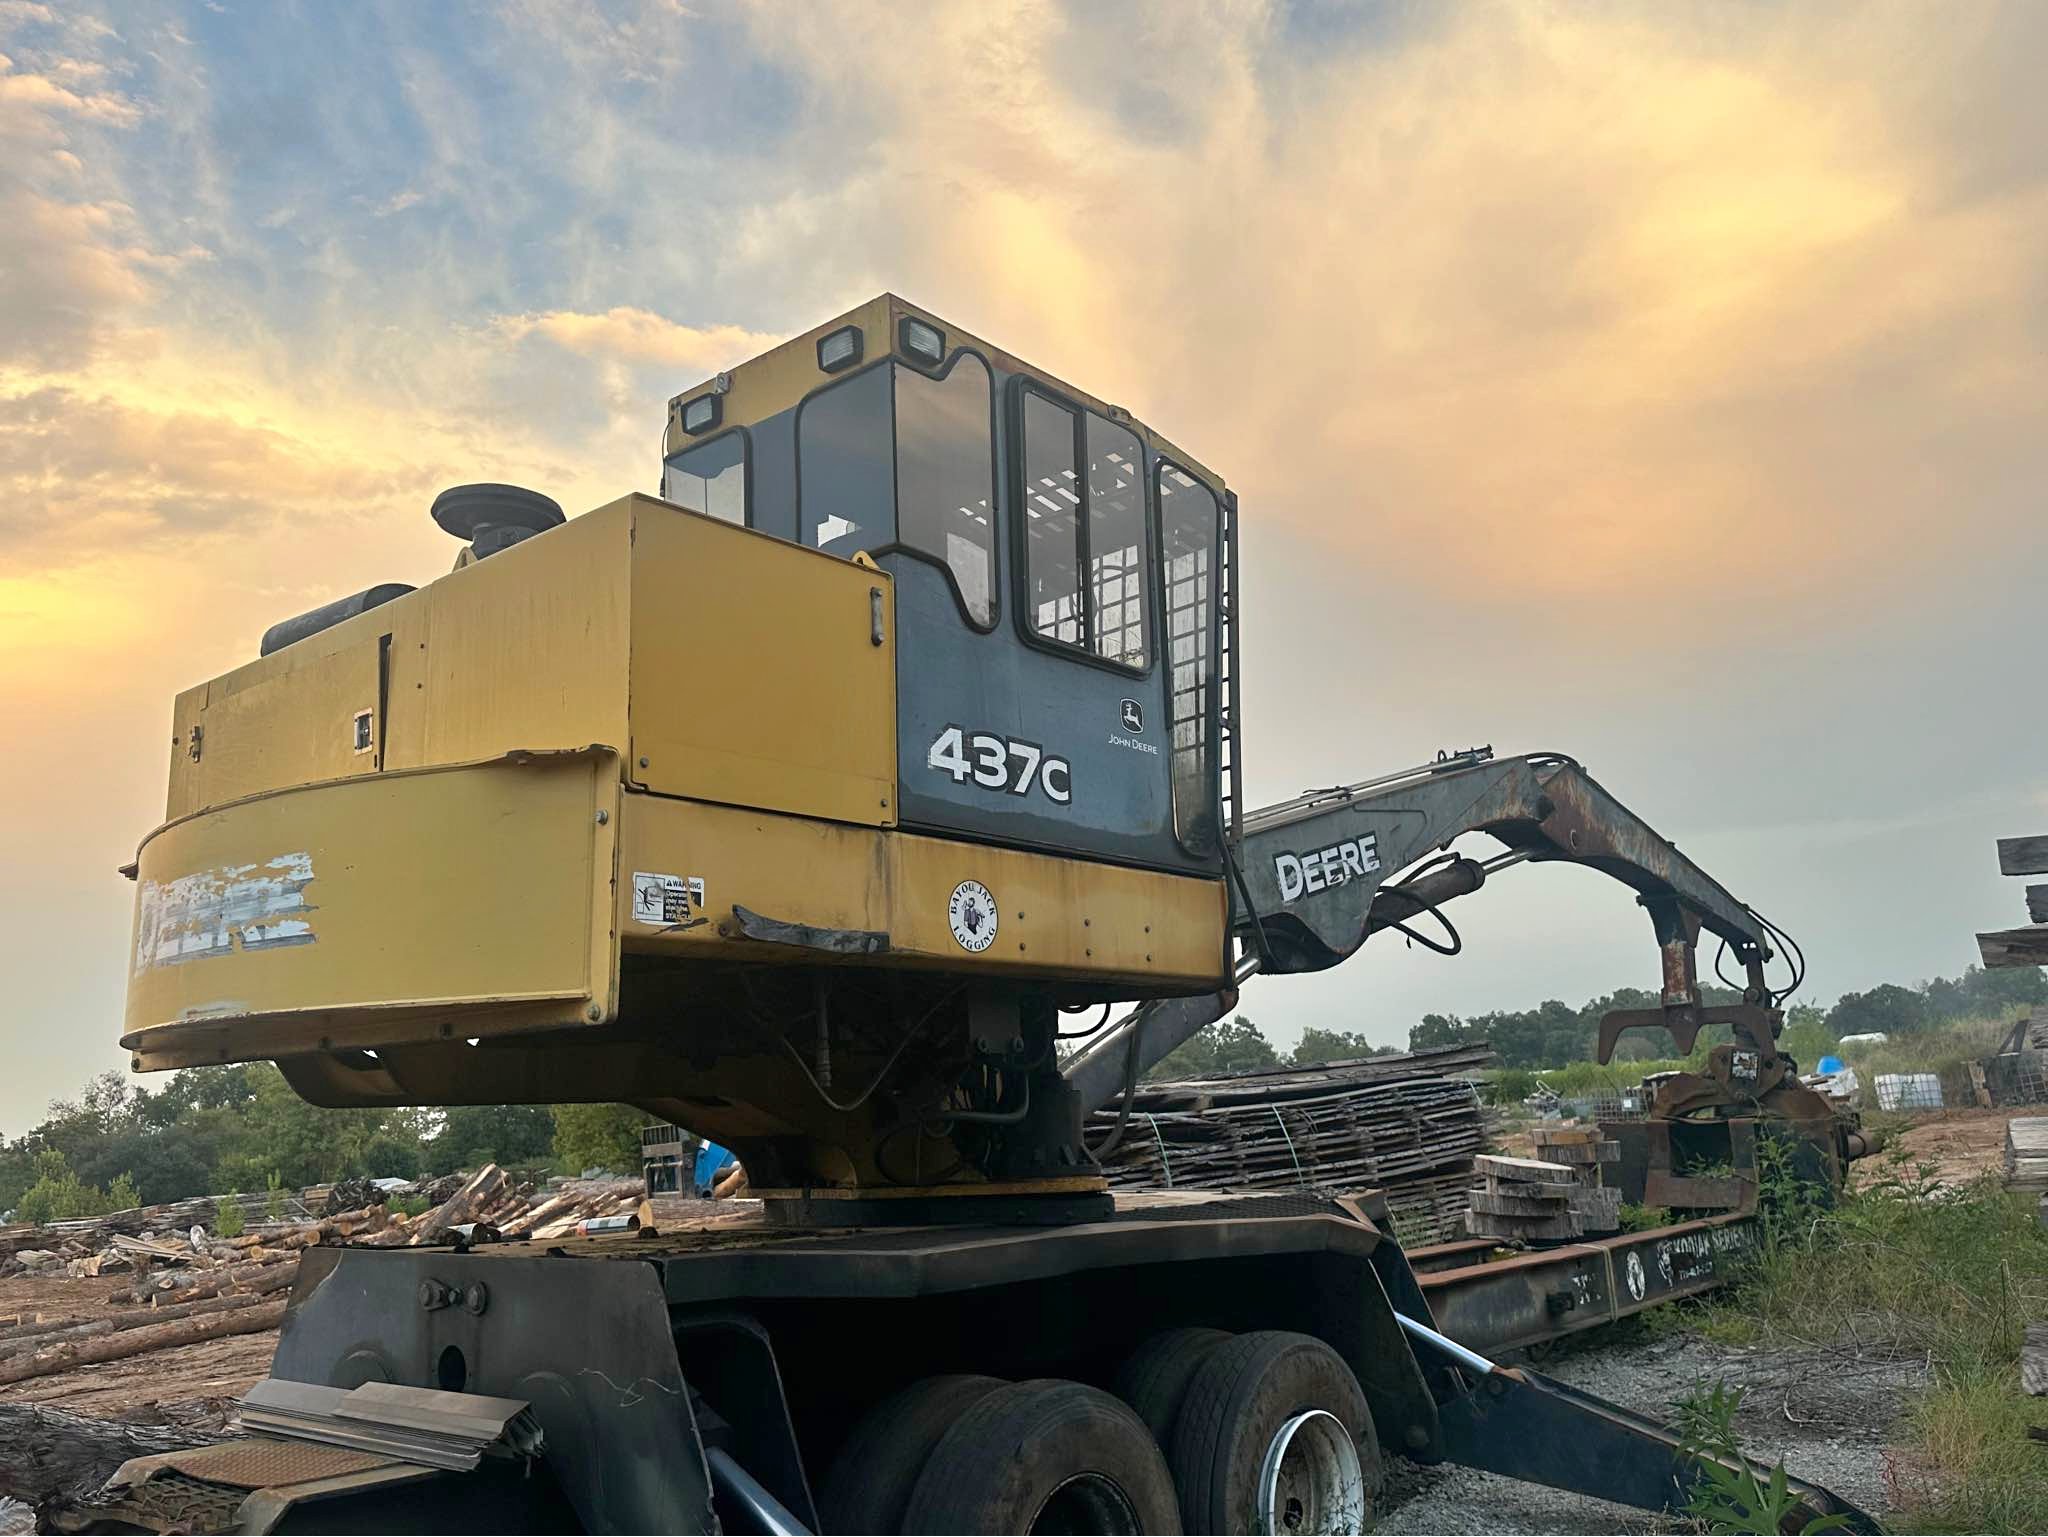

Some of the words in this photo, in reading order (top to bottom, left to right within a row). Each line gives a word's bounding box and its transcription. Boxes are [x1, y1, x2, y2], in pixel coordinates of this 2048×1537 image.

[1108, 733, 1131, 748] JOHN
[1131, 738, 1158, 755] DEERE
[927, 726, 1070, 802] 437C
[1275, 834, 1381, 902] DEERE
[672, 879, 702, 890] WARING
[950, 882, 976, 914] BAYOU
[976, 886, 996, 916] JACK
[953, 926, 996, 950] LOGGING
